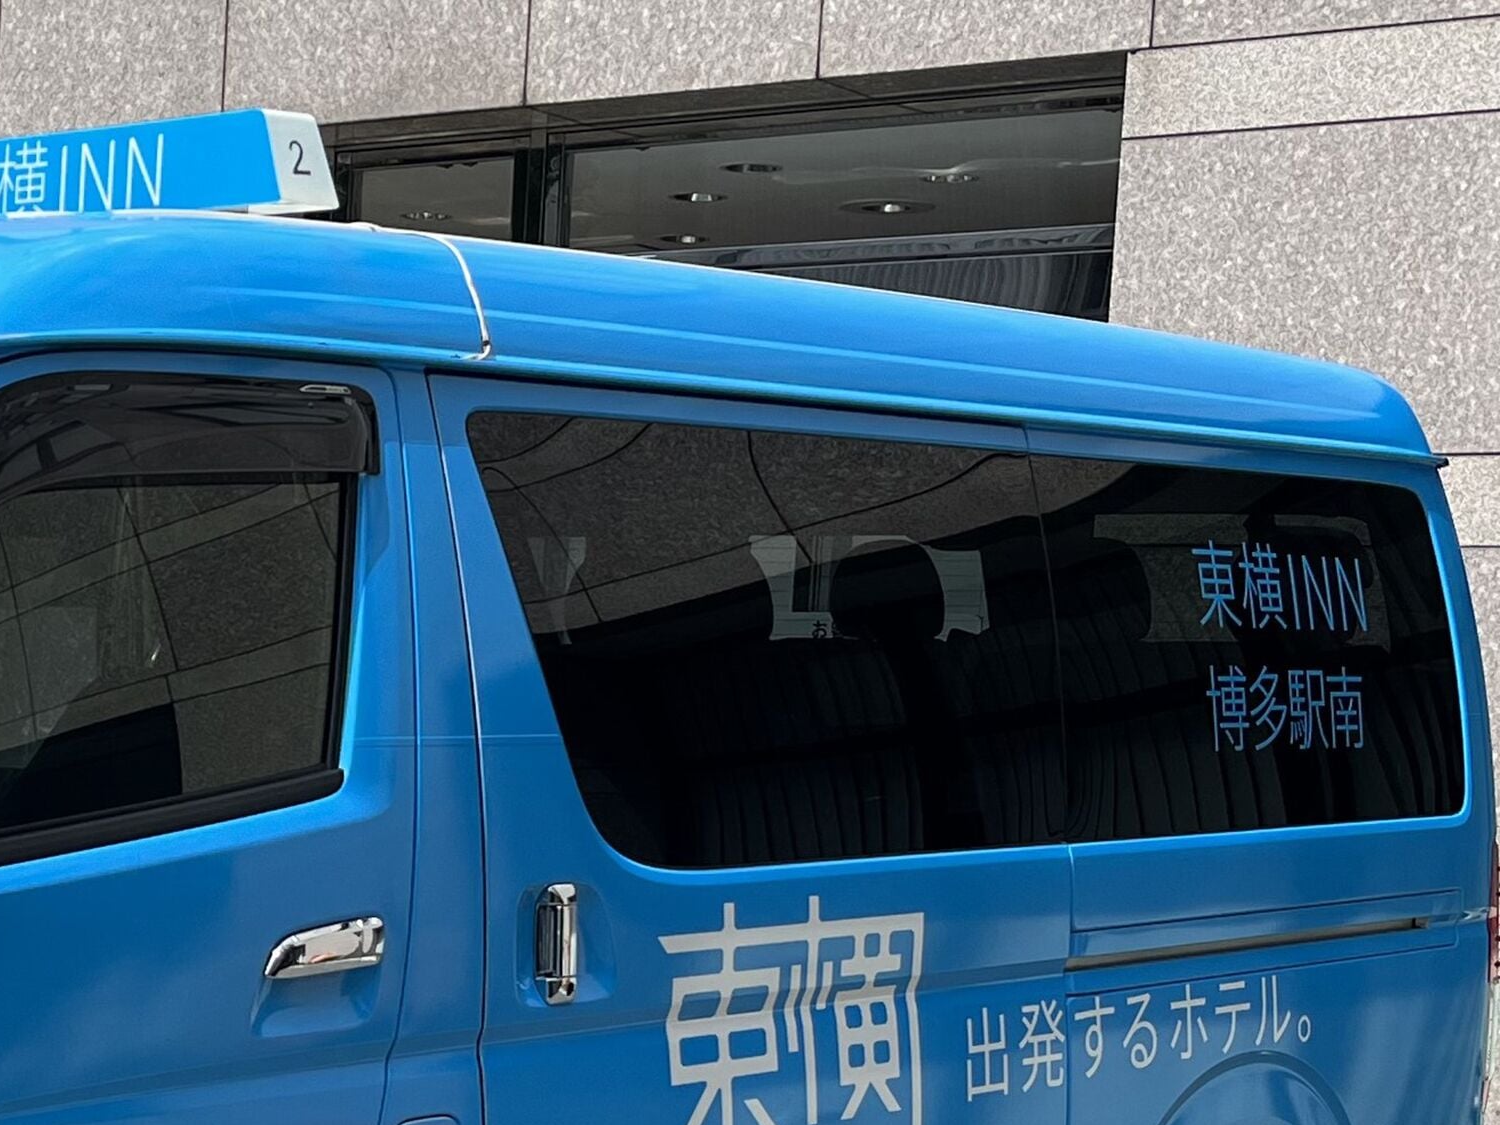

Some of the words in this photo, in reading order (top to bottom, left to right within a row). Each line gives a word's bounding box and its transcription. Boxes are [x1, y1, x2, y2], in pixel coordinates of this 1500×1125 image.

[288, 139, 311, 175] 2
[1192, 540, 1368, 631] 東横INN
[1206, 665, 1364, 751] 博多駅南
[965, 975, 1312, 1102] 出発するホテル。
